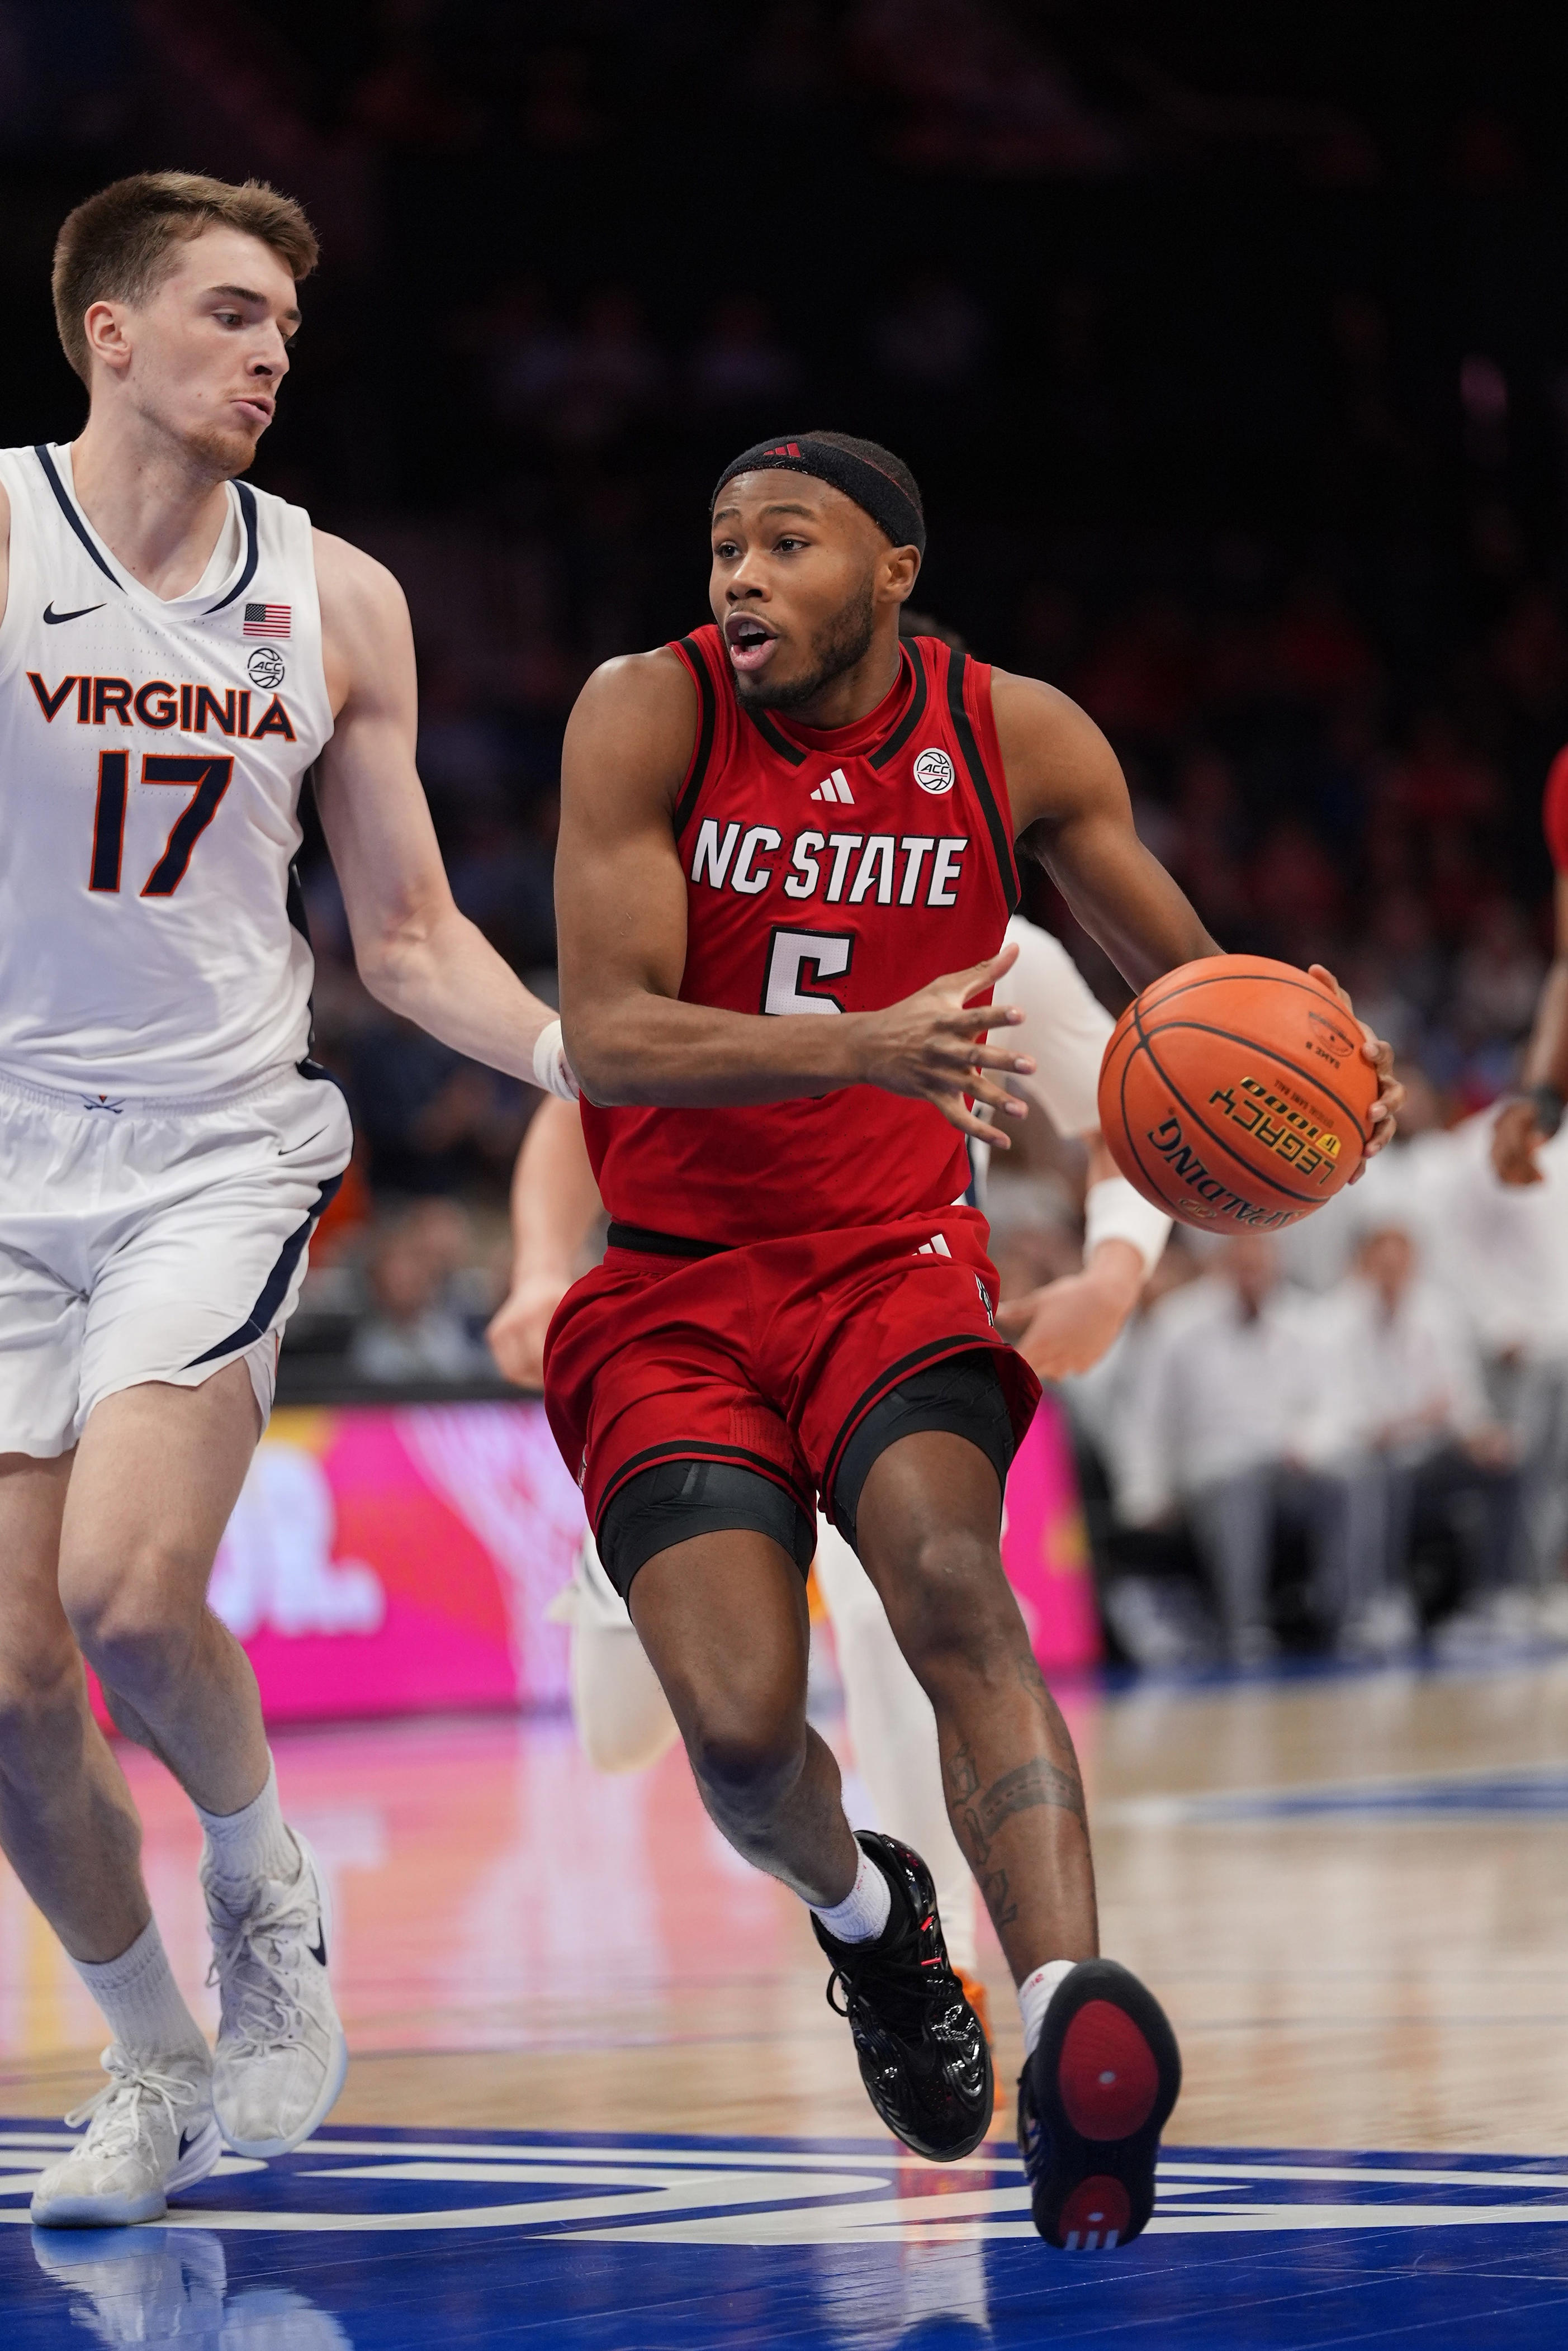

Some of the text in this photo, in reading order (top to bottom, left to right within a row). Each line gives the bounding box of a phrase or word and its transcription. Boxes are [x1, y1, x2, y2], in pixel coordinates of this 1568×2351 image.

[26, 671, 297, 742] VIRGINIA
[253, 662, 283, 671] ACC
[921, 764, 950, 774] ACC
[89, 750, 235, 897] 17
[690, 817, 969, 907] NC STATE
[1209, 1087, 1337, 1185] LEGACY
[1240, 1076, 1320, 1140] 1000
[1147, 1116, 1305, 1229] SPALDING
